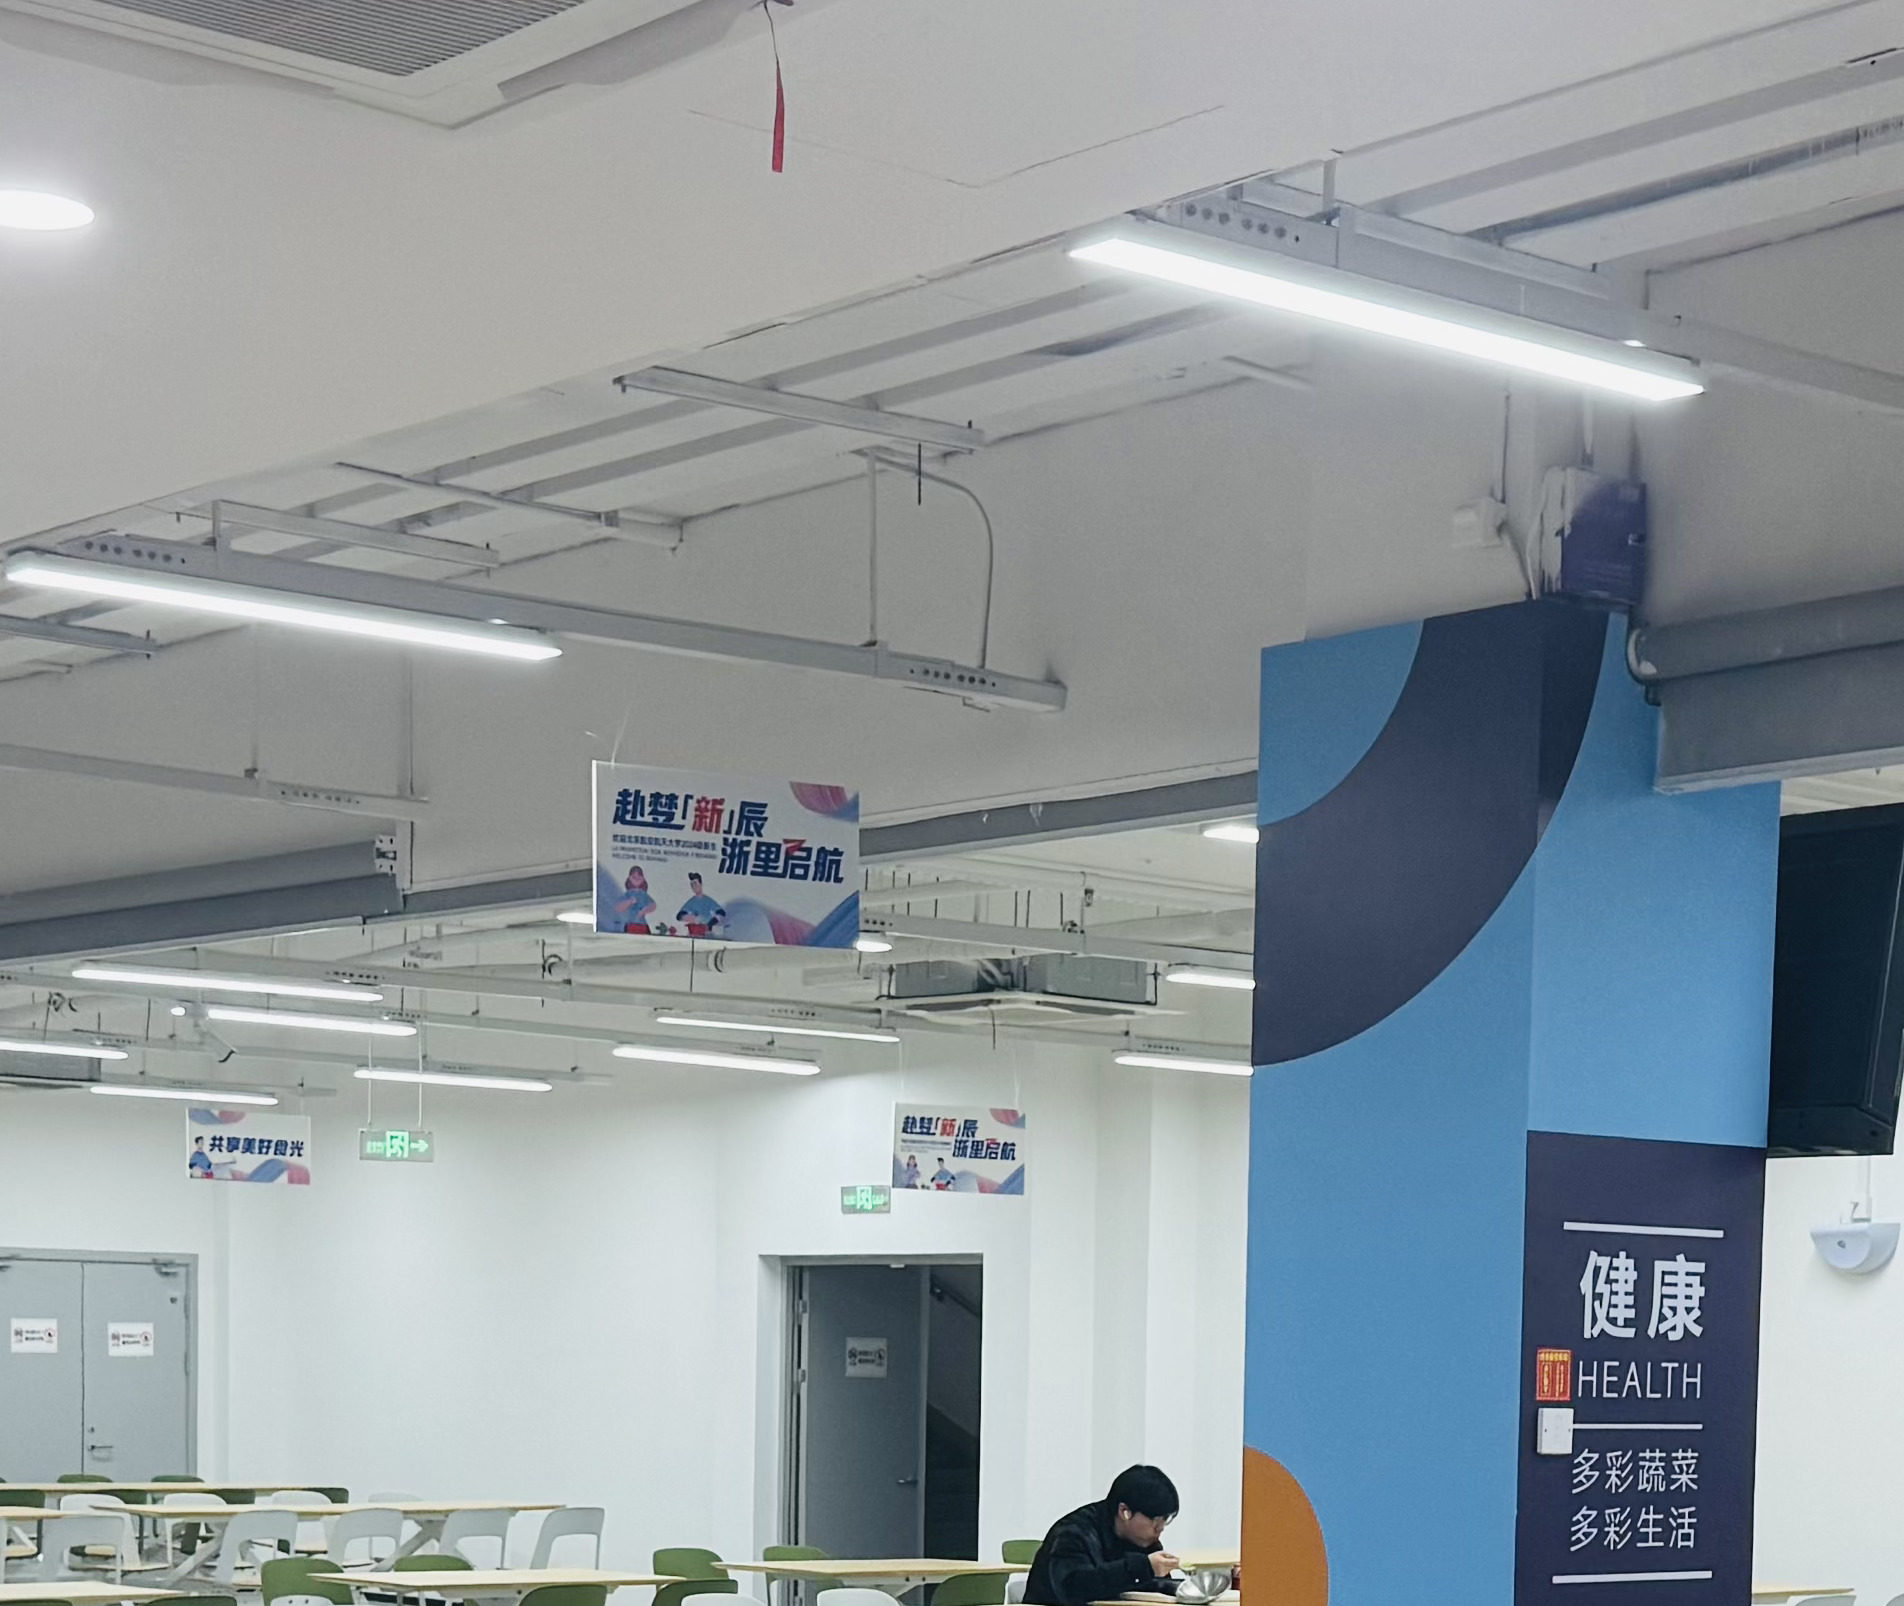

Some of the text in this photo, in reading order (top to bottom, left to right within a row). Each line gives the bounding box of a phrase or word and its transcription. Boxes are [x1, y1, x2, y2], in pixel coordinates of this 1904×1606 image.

[718, 837, 845, 884] 浙里启航
[209, 1135, 305, 1158] 共享美好食光
[952, 1138, 1017, 1161] 浙里启航
[1579, 1250, 1707, 1342] 健康
[1577, 1360, 1703, 1400] HEALTH
[1571, 1448, 1699, 1495] 多彩蔬菜
[1568, 1504, 1698, 1553] 多彩生活
